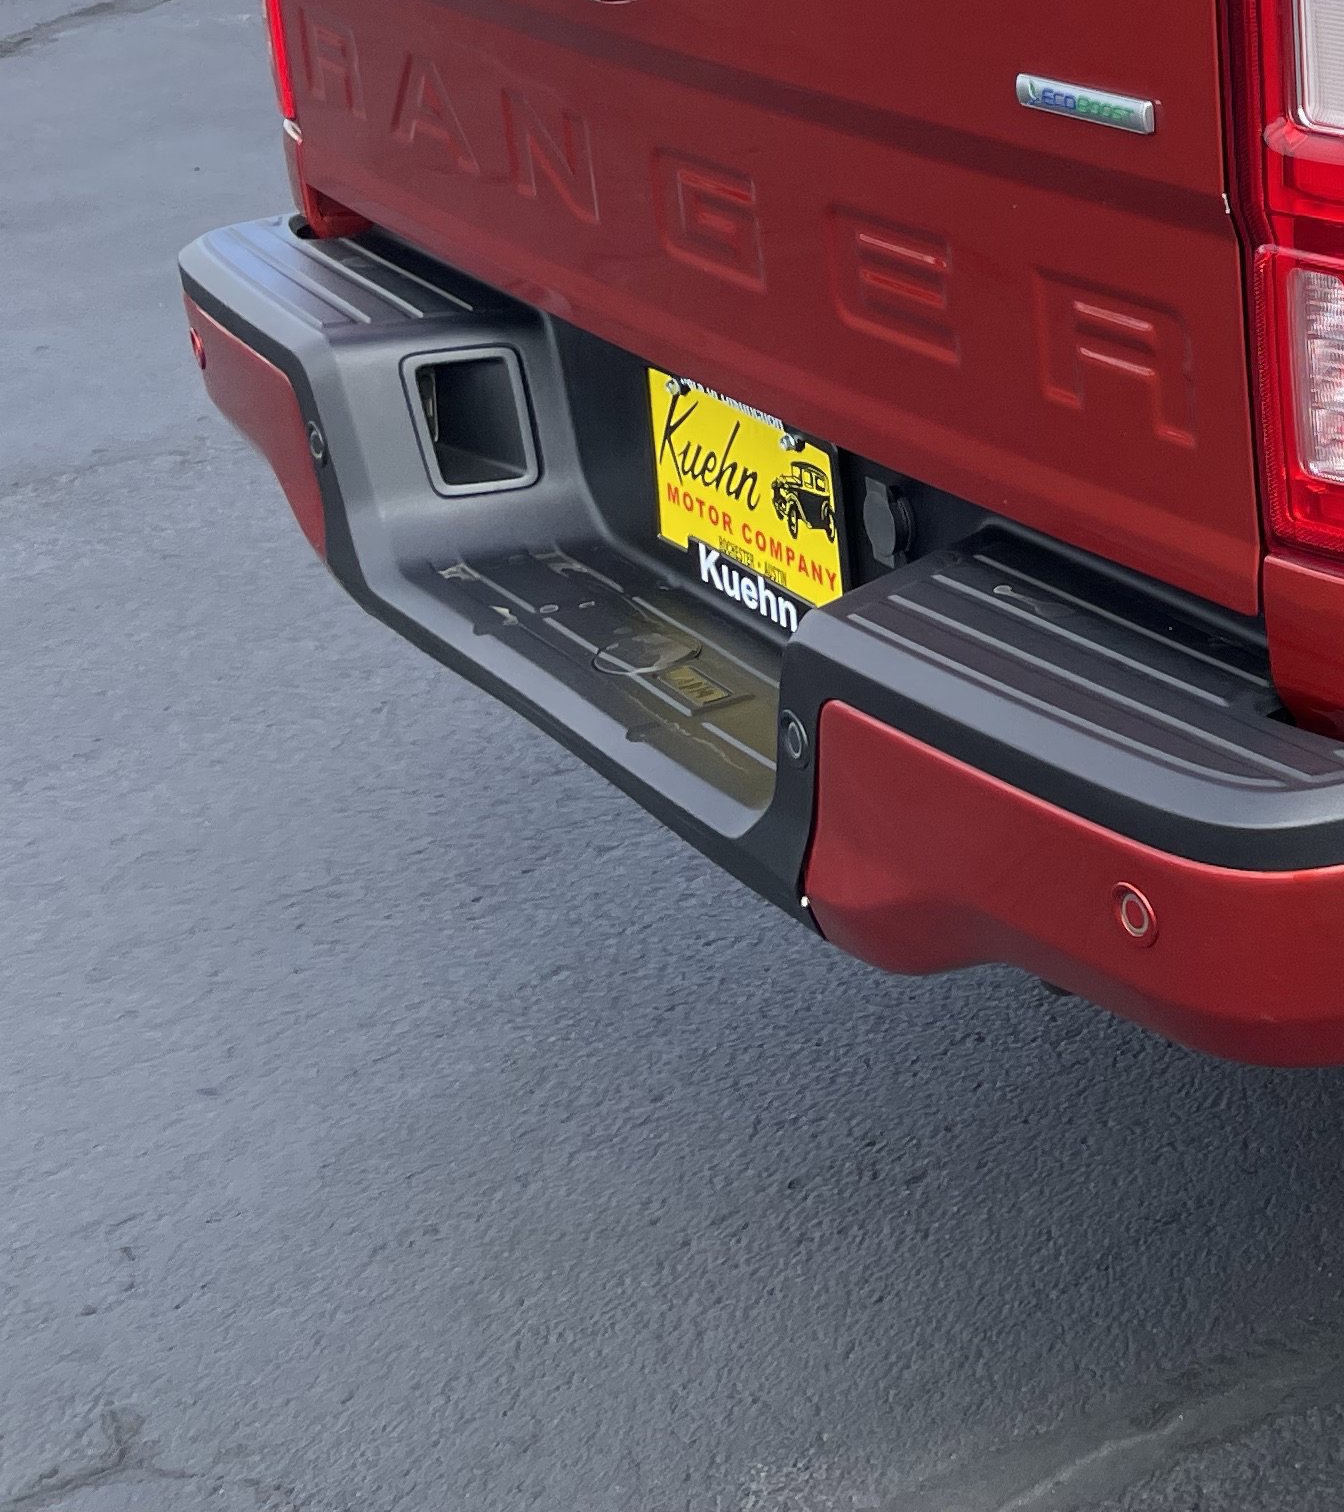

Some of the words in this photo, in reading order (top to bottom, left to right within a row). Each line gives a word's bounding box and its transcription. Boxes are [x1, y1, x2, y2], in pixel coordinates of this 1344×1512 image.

[301, 5, 1198, 450] RANGER
[659, 391, 761, 511] Kuehn
[667, 483, 733, 535] MOTOR
[741, 522, 837, 592] COMPANY
[698, 542, 799, 633] Kuehn
